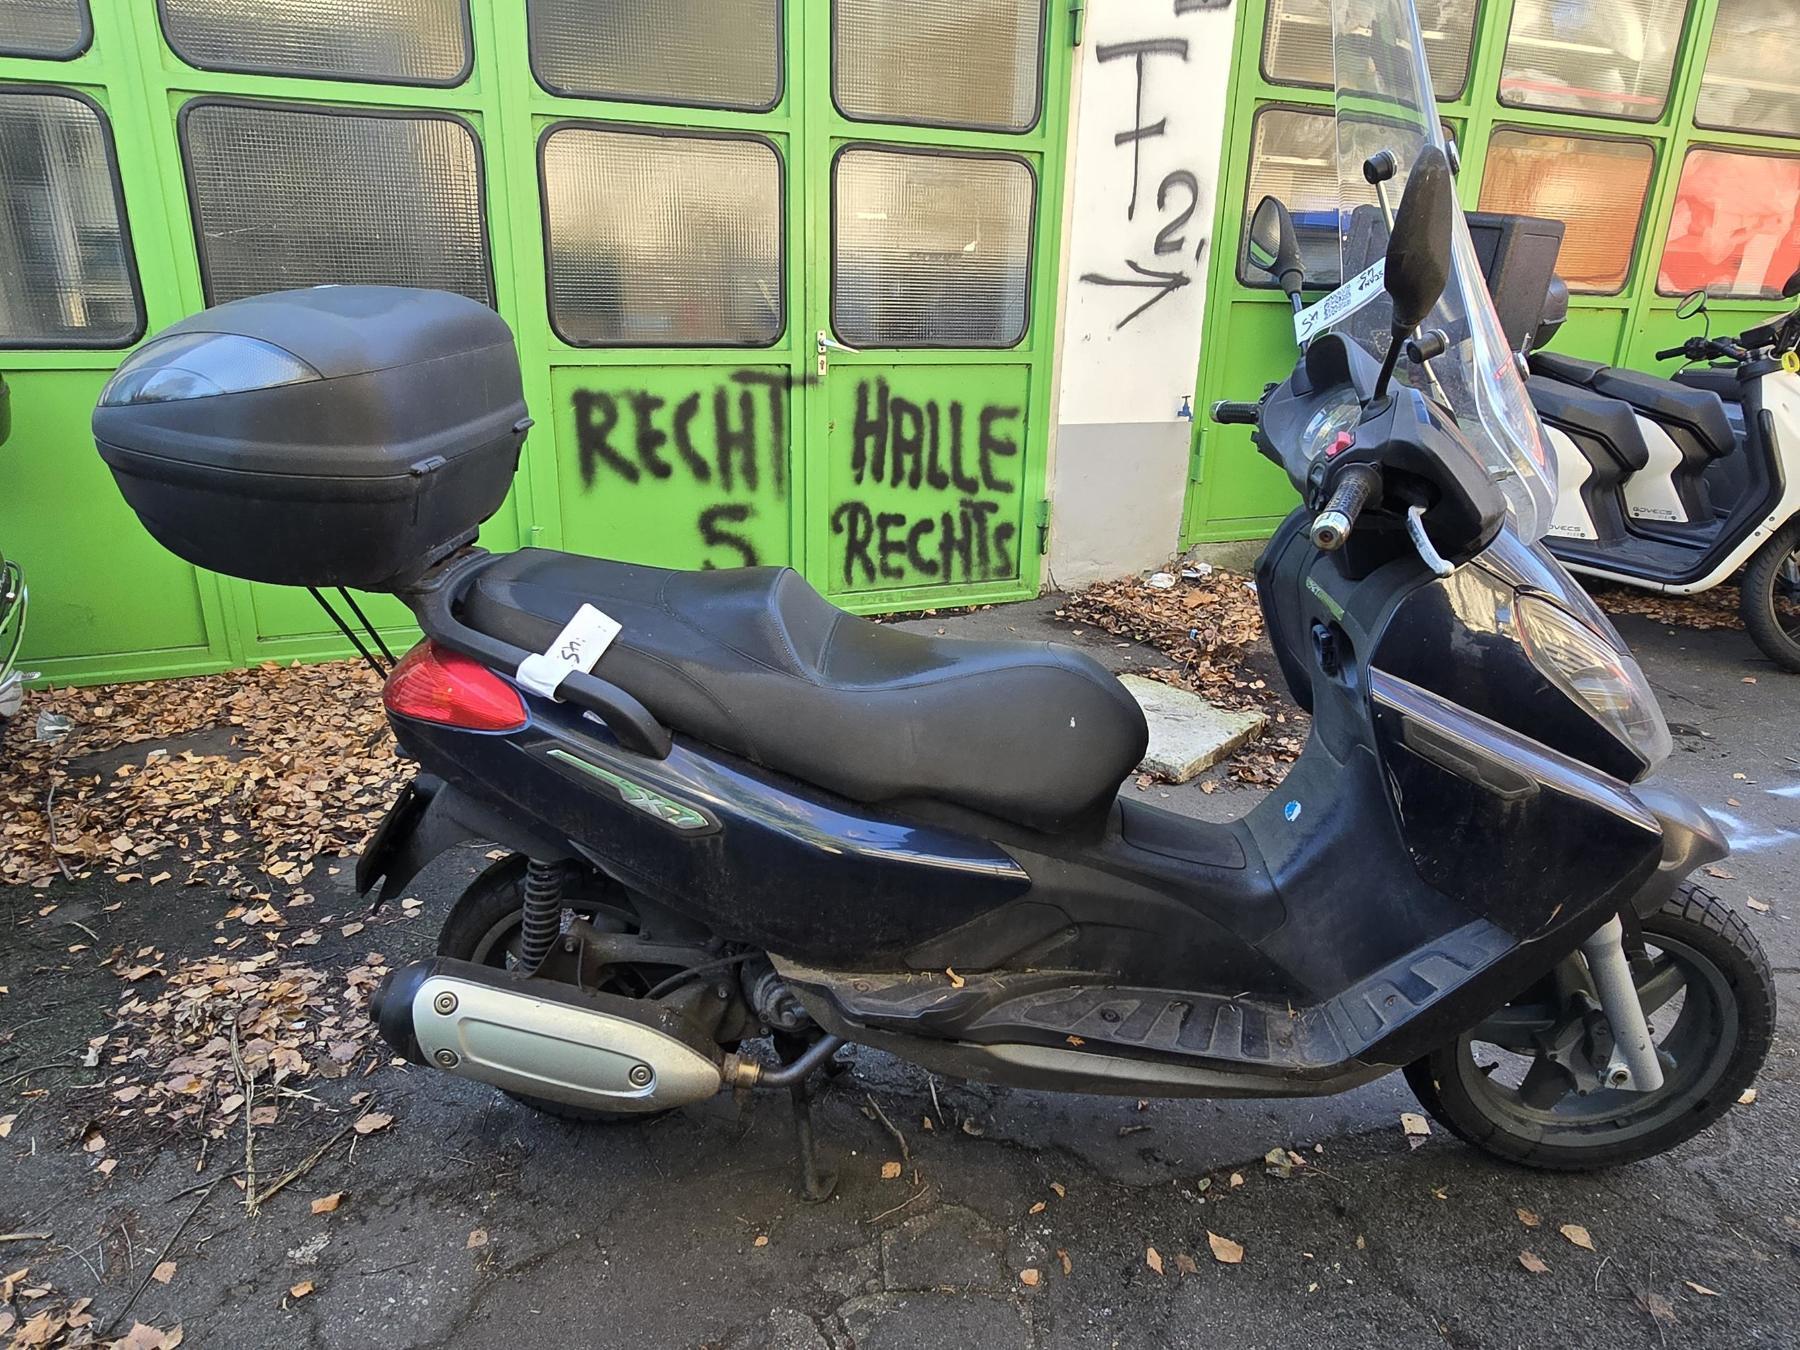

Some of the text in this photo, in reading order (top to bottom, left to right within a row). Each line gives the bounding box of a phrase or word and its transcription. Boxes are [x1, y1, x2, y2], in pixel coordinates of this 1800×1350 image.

[571, 370, 818, 497] RECHT
[851, 376, 1020, 493] HALLE
[699, 504, 757, 569] S
[832, 498, 1015, 586] RECHTS
[1632, 506, 1672, 516] GOVECS
